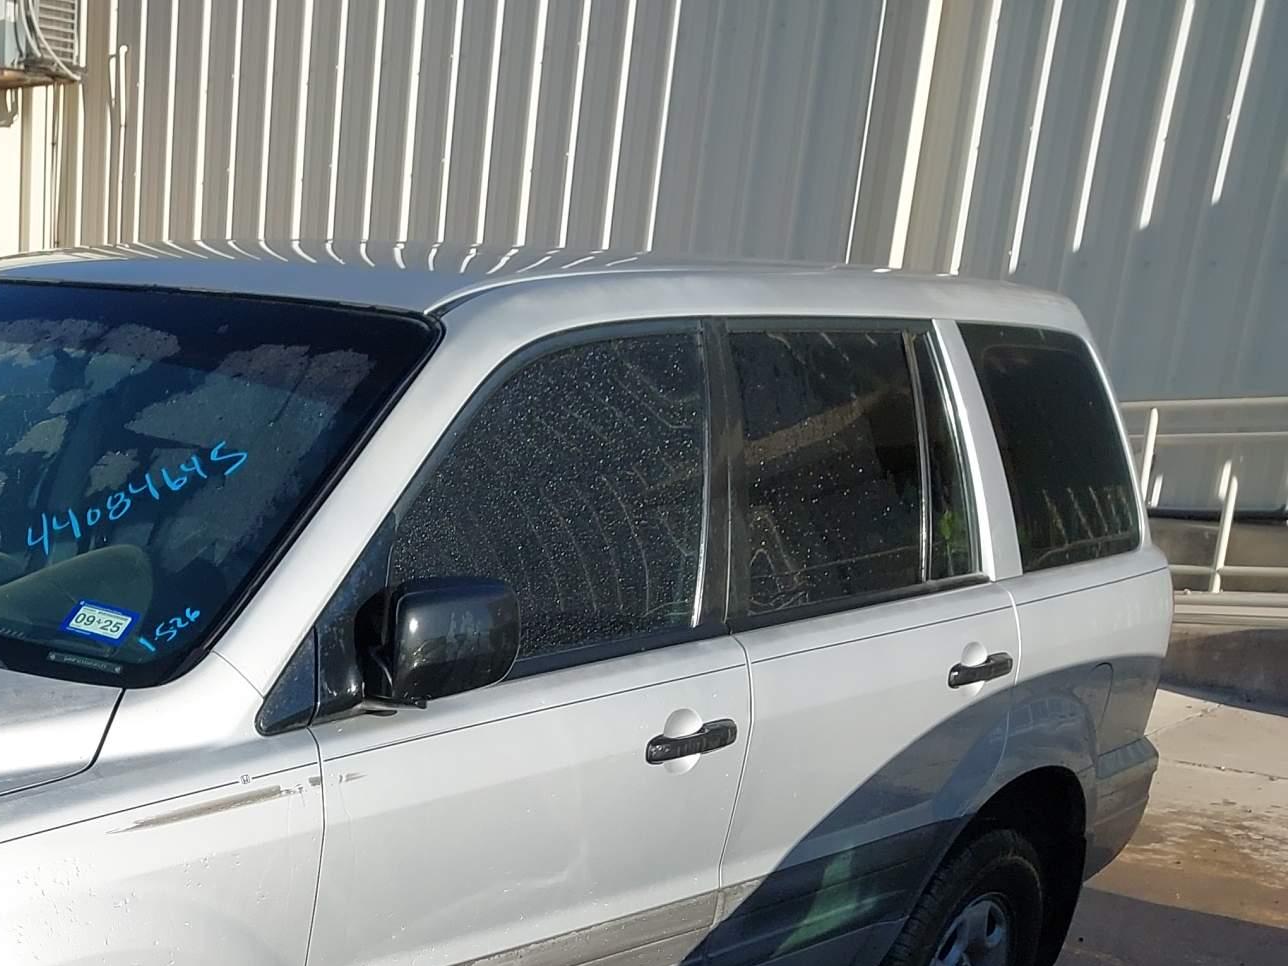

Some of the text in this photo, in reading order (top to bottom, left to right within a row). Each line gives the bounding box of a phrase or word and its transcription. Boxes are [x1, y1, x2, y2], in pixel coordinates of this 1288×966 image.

[27, 441, 248, 555] 44084645
[74, 612, 96, 627] 09
[99, 619, 123, 633] 25
